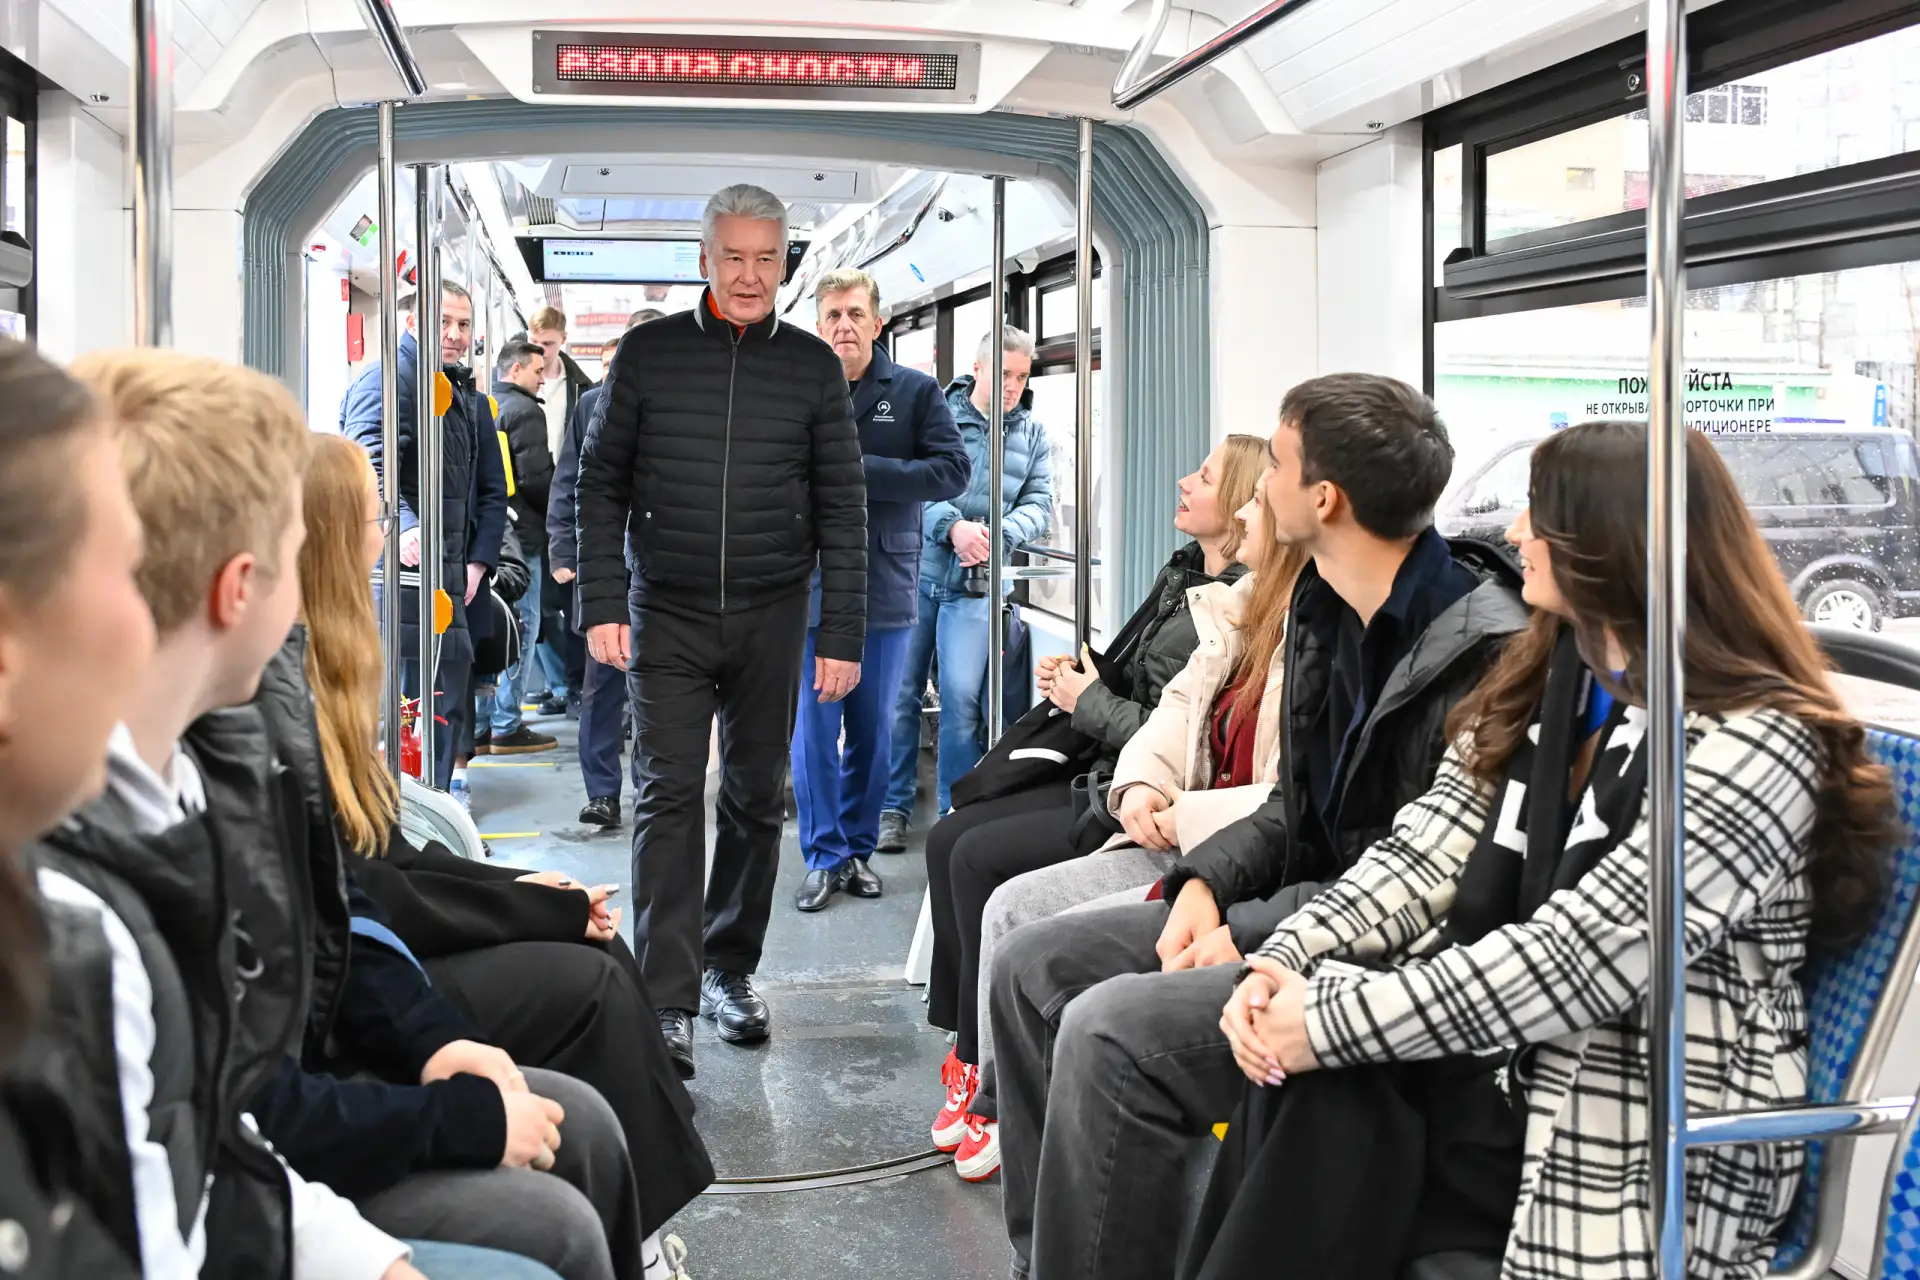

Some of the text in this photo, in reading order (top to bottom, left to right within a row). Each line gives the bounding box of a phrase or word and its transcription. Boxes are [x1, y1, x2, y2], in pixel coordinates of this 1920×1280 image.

[1619, 368, 1733, 394] ПОЖЙСТА
[1586, 398, 1775, 415] НЕ ОТКРЫВ ОРТОЧКИ ПРИ
